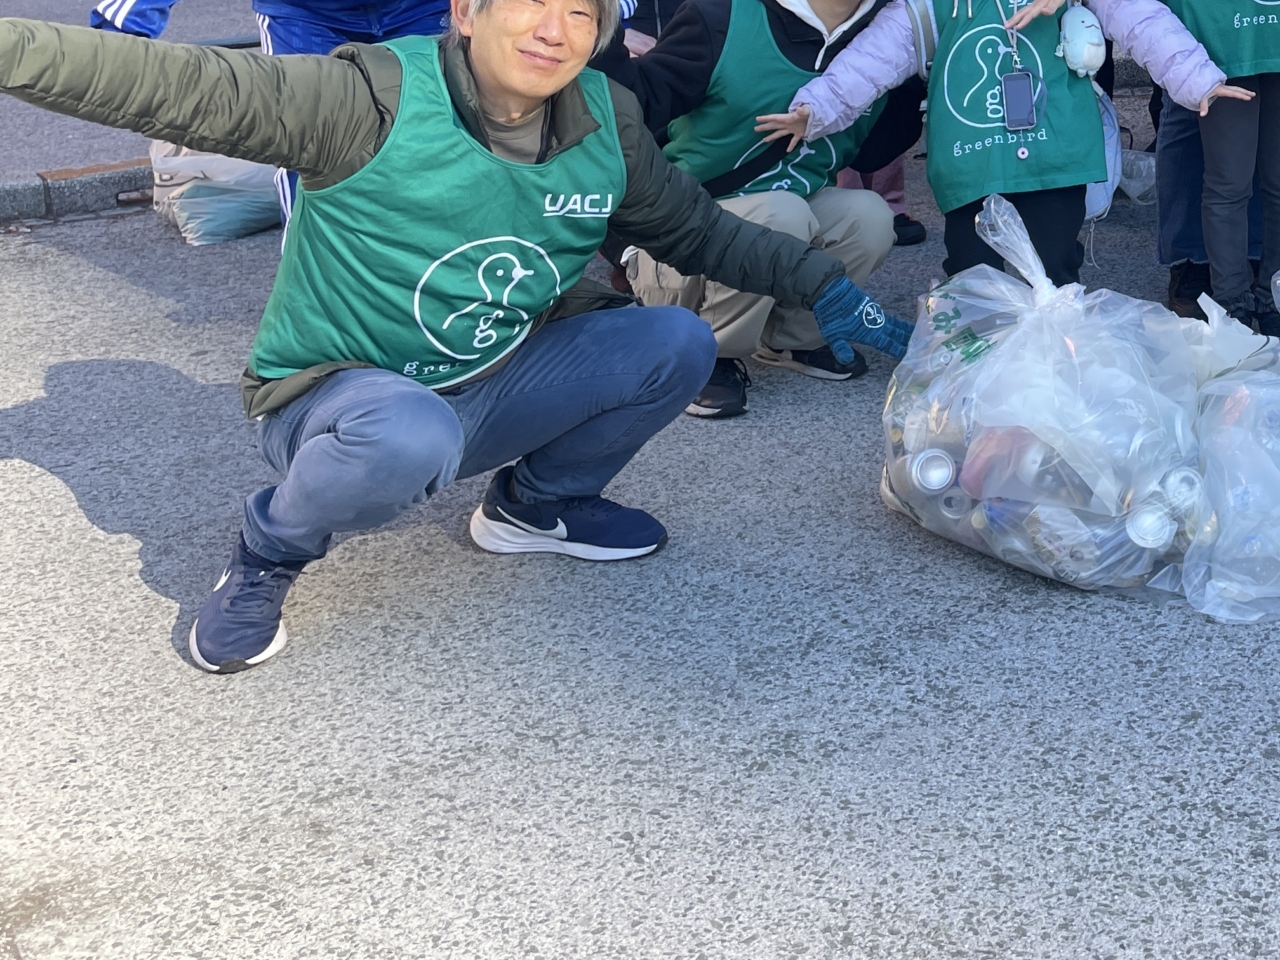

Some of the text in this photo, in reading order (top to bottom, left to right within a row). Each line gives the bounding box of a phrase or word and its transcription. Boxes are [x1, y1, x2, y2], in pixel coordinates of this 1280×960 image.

[1233, 10, 1279, 30] green
[953, 133, 1005, 157] green
[543, 192, 613, 218] UACJ
[402, 361, 464, 378] gre
